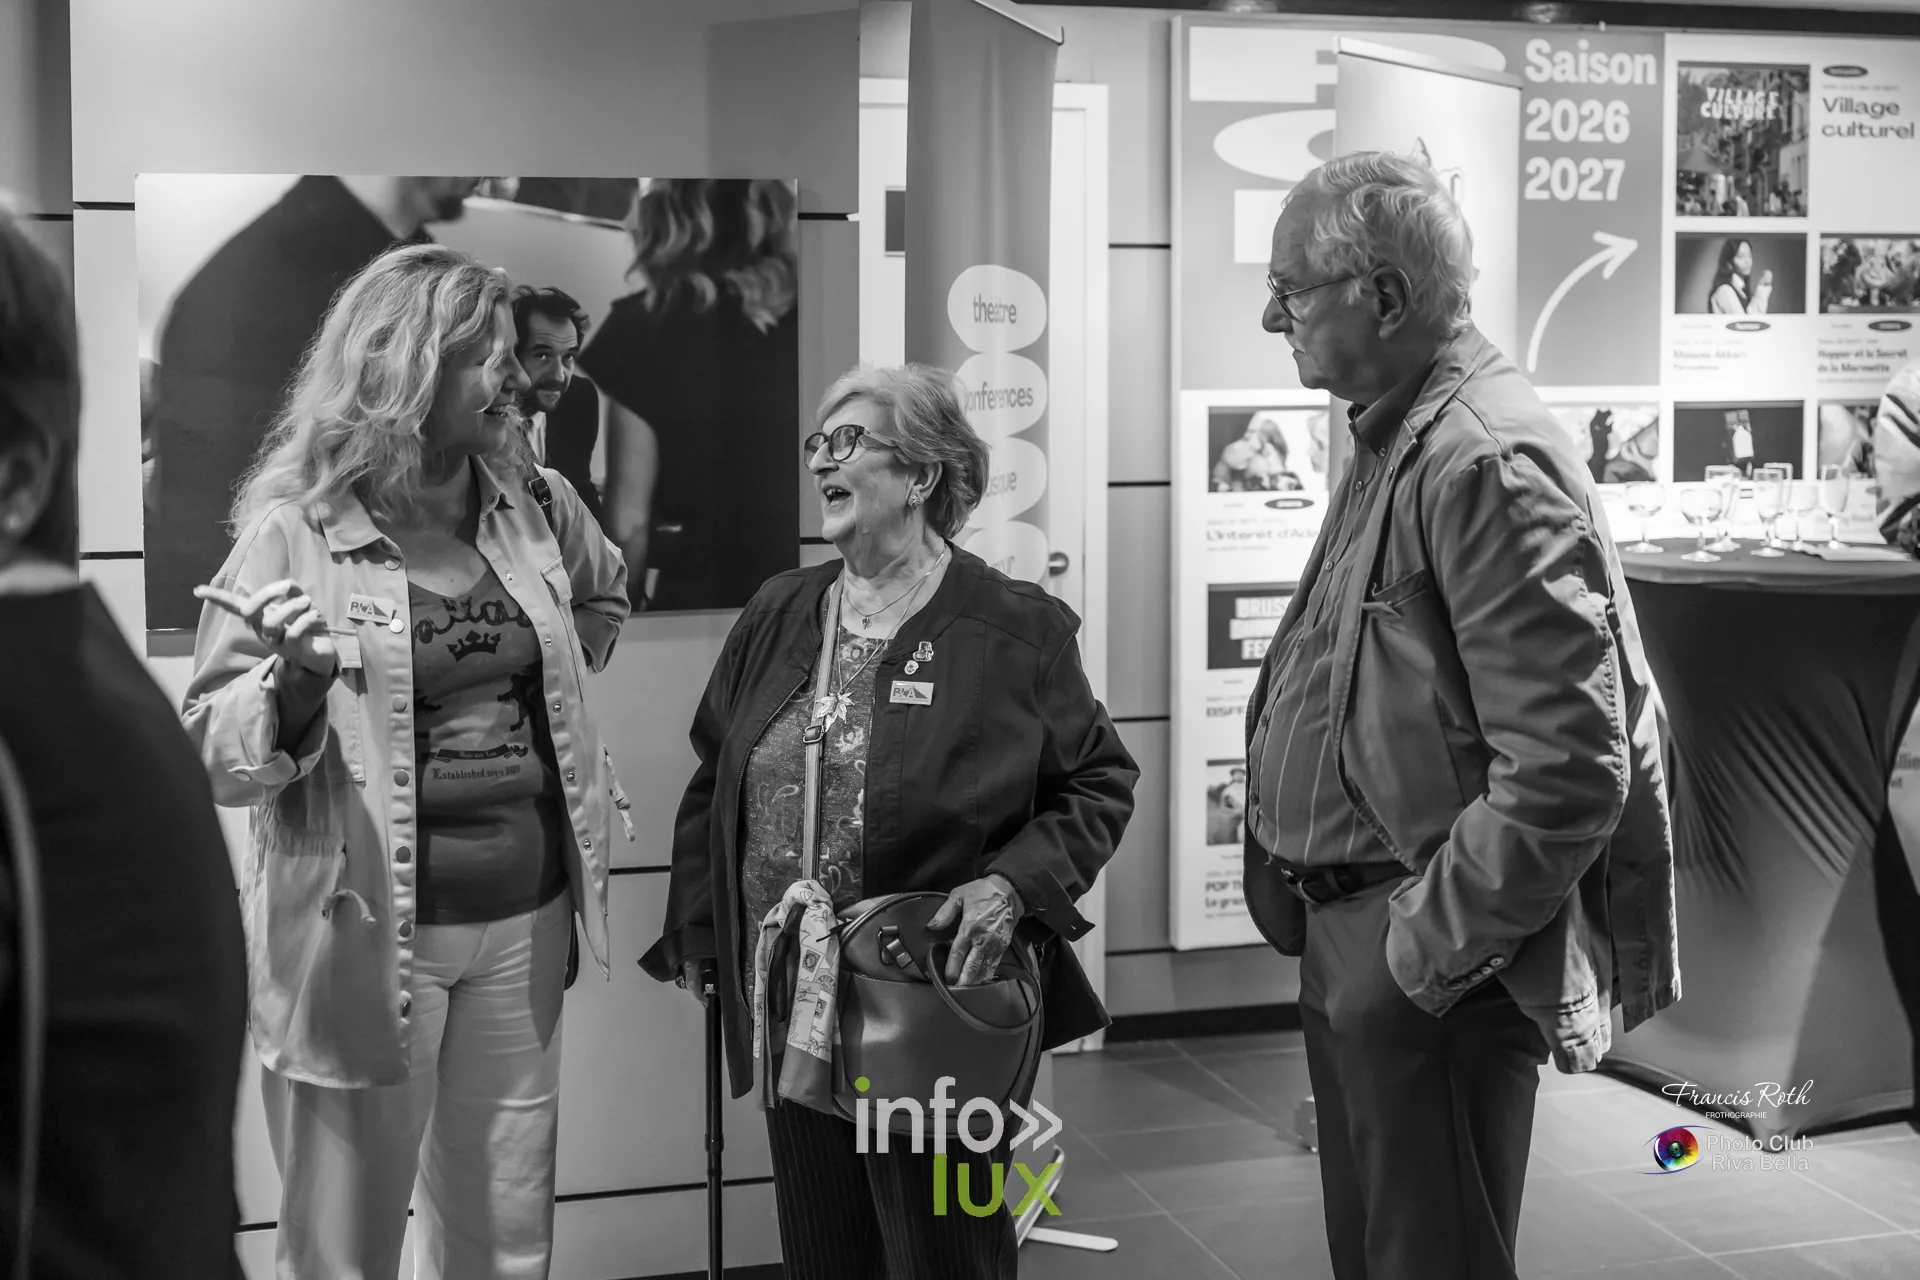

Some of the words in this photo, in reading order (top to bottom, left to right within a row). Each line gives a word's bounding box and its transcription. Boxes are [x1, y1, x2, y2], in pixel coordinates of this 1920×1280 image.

[1525, 38, 1657, 85] Saison
[1525, 97, 1630, 144] 2026
[1821, 121, 1915, 139] culturel
[1822, 97, 1901, 120] Village
[1524, 156, 1626, 201] 2027
